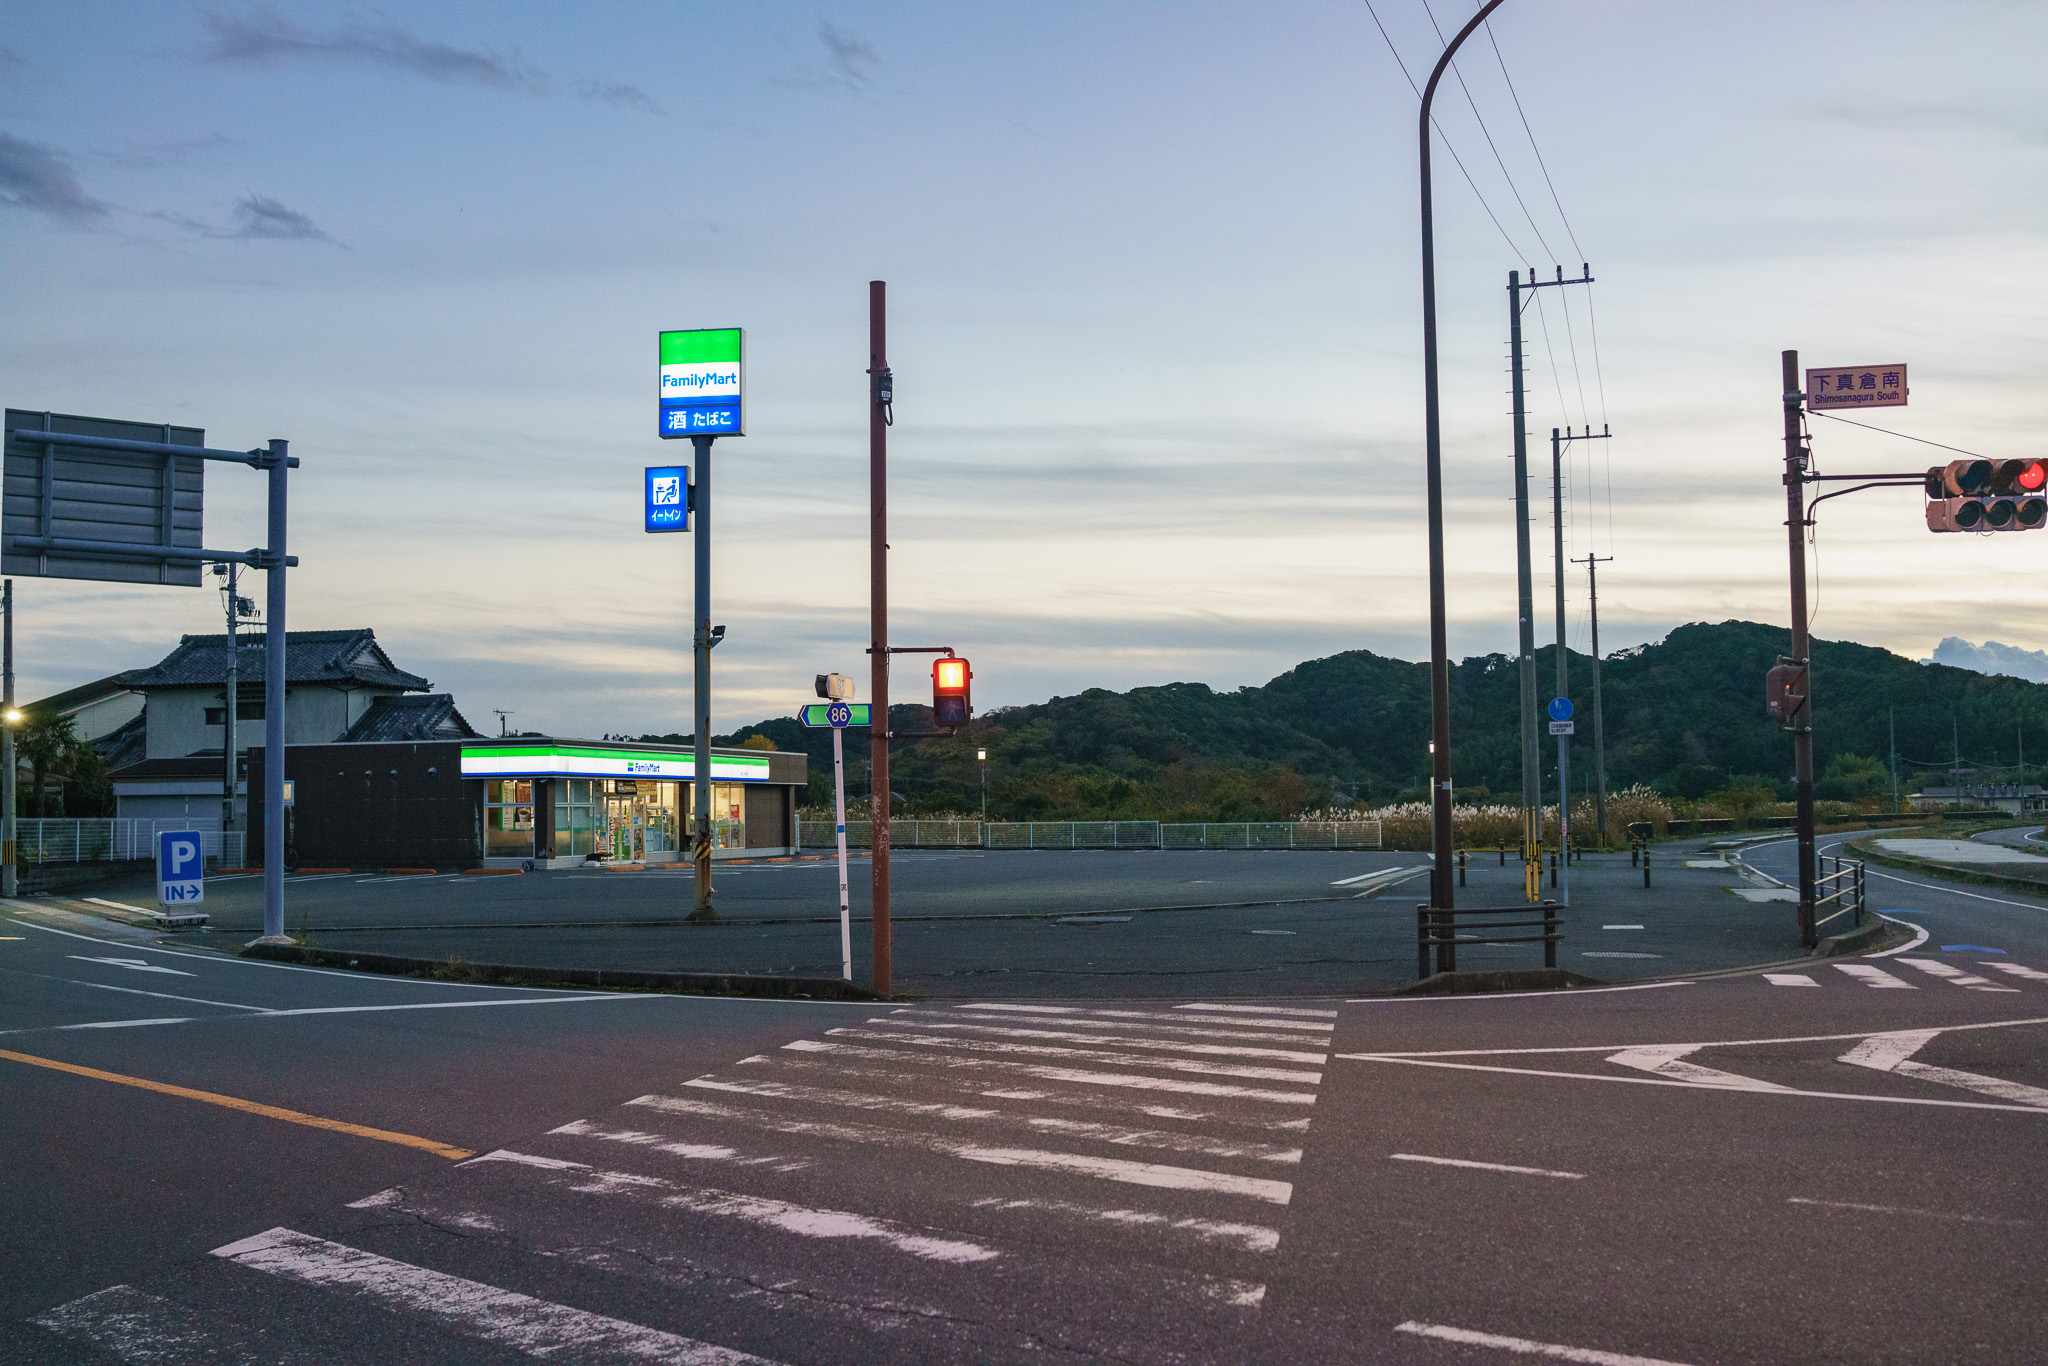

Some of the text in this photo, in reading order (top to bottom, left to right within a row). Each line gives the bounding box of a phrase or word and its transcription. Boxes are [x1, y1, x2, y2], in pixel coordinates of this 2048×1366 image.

[662, 372, 737, 389] FamilyMart
[1813, 371, 1900, 392] 下真倉南
[1814, 390, 1900, 404] Shimosanagura South
[668, 410, 731, 429] 酒 たばこ
[651, 508, 682, 522] イートイン
[831, 707, 848, 722] 86
[635, 762, 660, 773] FamilyMart
[171, 840, 196, 874] P
[165, 885, 185, 900] IN
